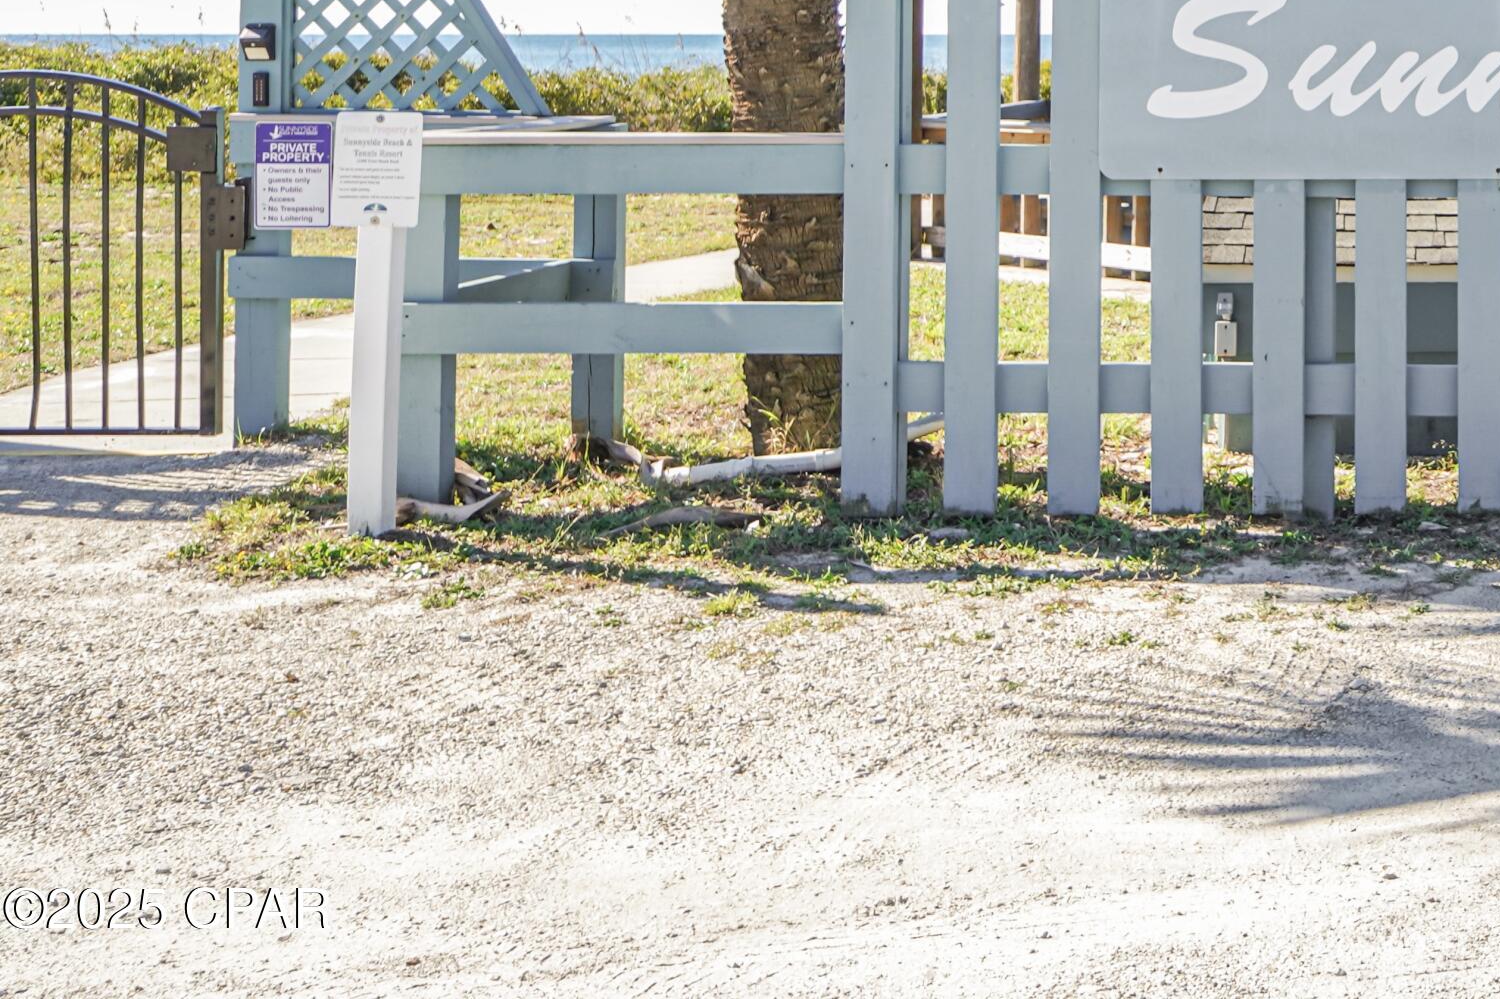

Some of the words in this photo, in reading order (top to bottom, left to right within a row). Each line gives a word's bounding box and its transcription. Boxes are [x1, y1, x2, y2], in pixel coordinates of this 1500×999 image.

[343, 137, 381, 147] Sunnyside
[383, 138, 405, 146] Beach
[406, 138, 413, 146] &
[269, 143, 317, 154] PRIVATE
[262, 152, 325, 163] PROPERTY
[267, 177, 293, 185] guests
[294, 176, 311, 185] only
[281, 205, 325, 214] Trespassing
[280, 215, 314, 223] Loitering
